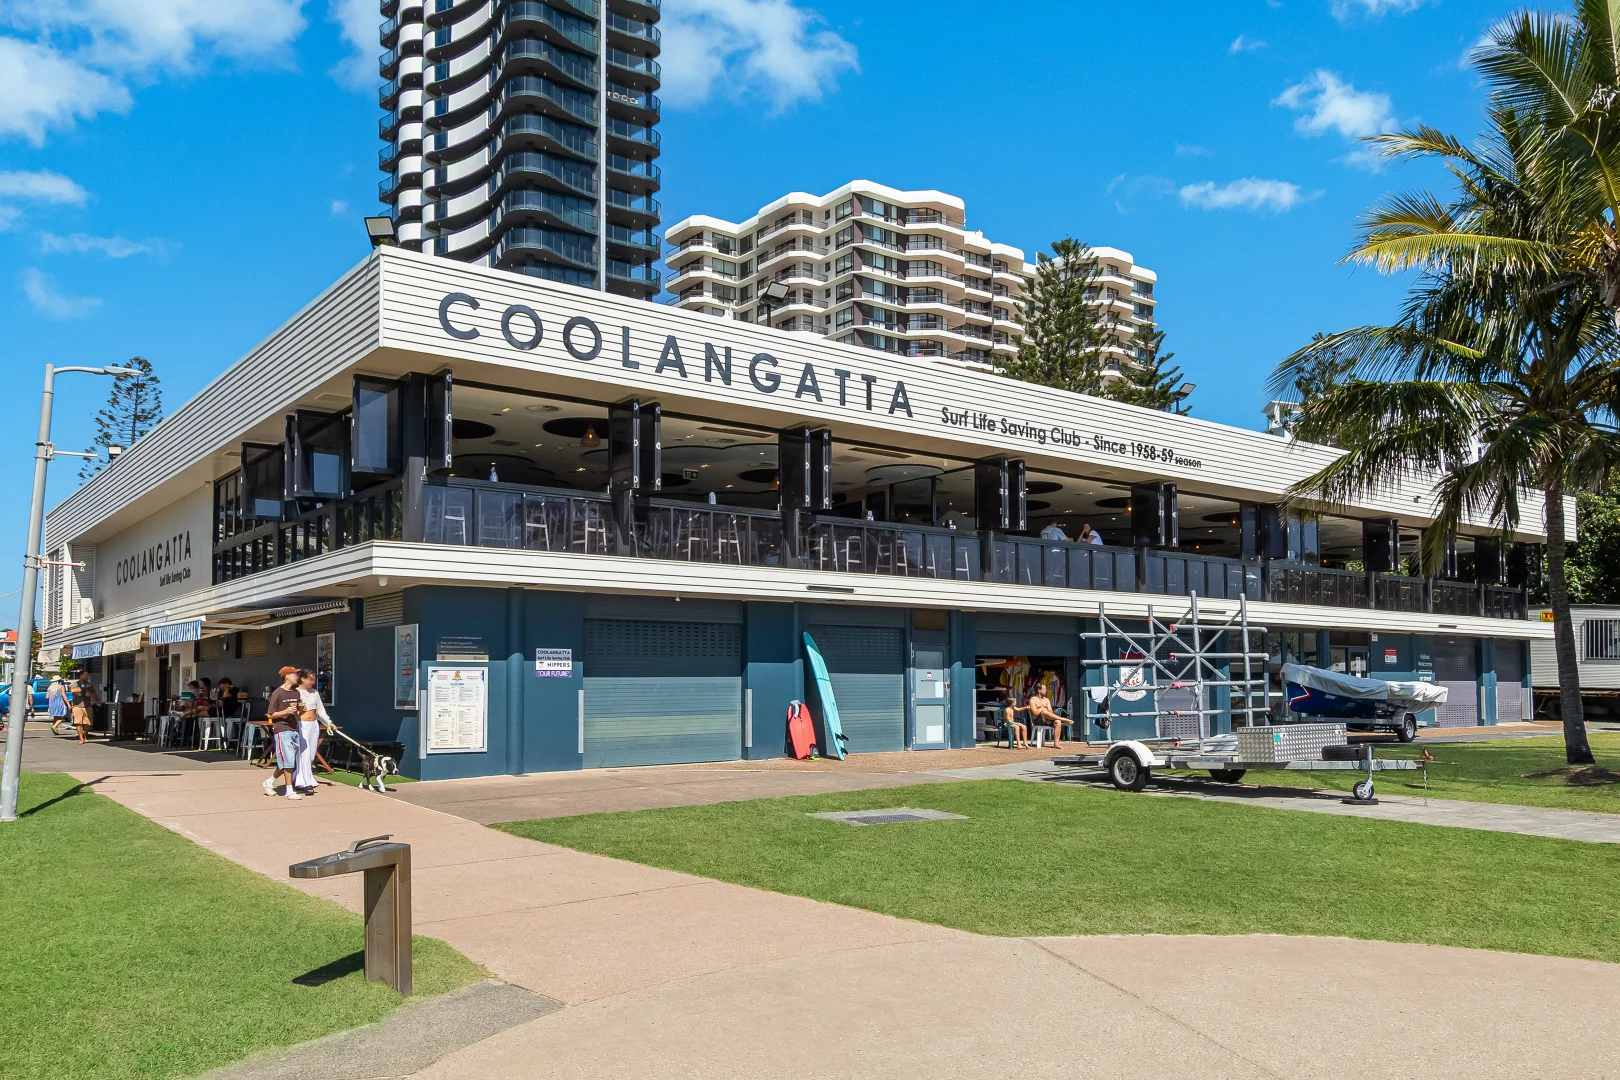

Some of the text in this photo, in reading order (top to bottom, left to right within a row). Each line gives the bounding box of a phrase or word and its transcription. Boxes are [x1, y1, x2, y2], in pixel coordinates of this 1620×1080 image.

[438, 292, 914, 418] COOLANGATTA
[941, 406, 969, 427] Surf
[973, 412, 996, 431] Life
[1000, 417, 1046, 445] Saving
[1051, 427, 1081, 447] Club
[1093, 434, 1127, 455] Since
[1131, 442, 1174, 463] 1958-59
[1174, 456, 1202, 468] season
[116, 530, 191, 586] COOLANGATTA
[183, 566, 191, 579] Club
